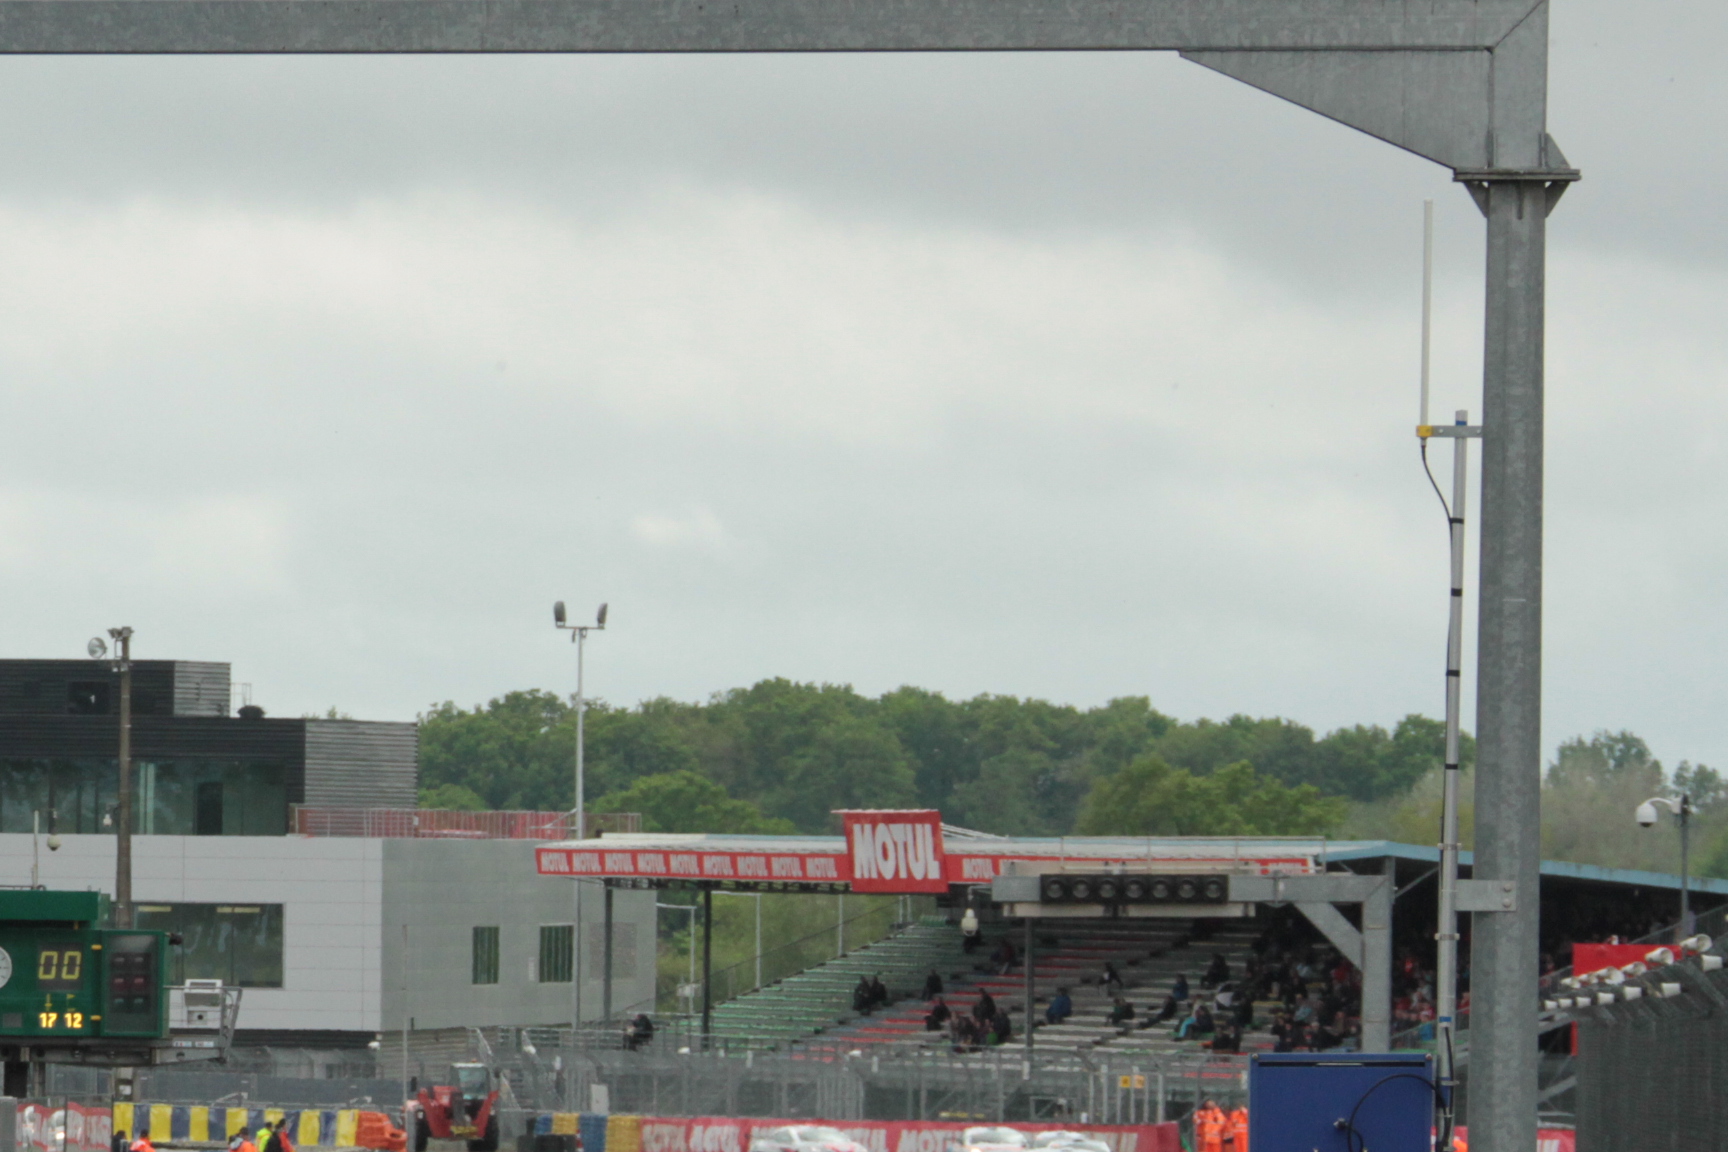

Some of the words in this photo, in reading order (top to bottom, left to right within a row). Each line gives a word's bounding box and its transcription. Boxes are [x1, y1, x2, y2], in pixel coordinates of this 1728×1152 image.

[853, 823, 941, 880] MOTUL
[39, 1012, 58, 1029] 17
[63, 1012, 83, 1029] 12
